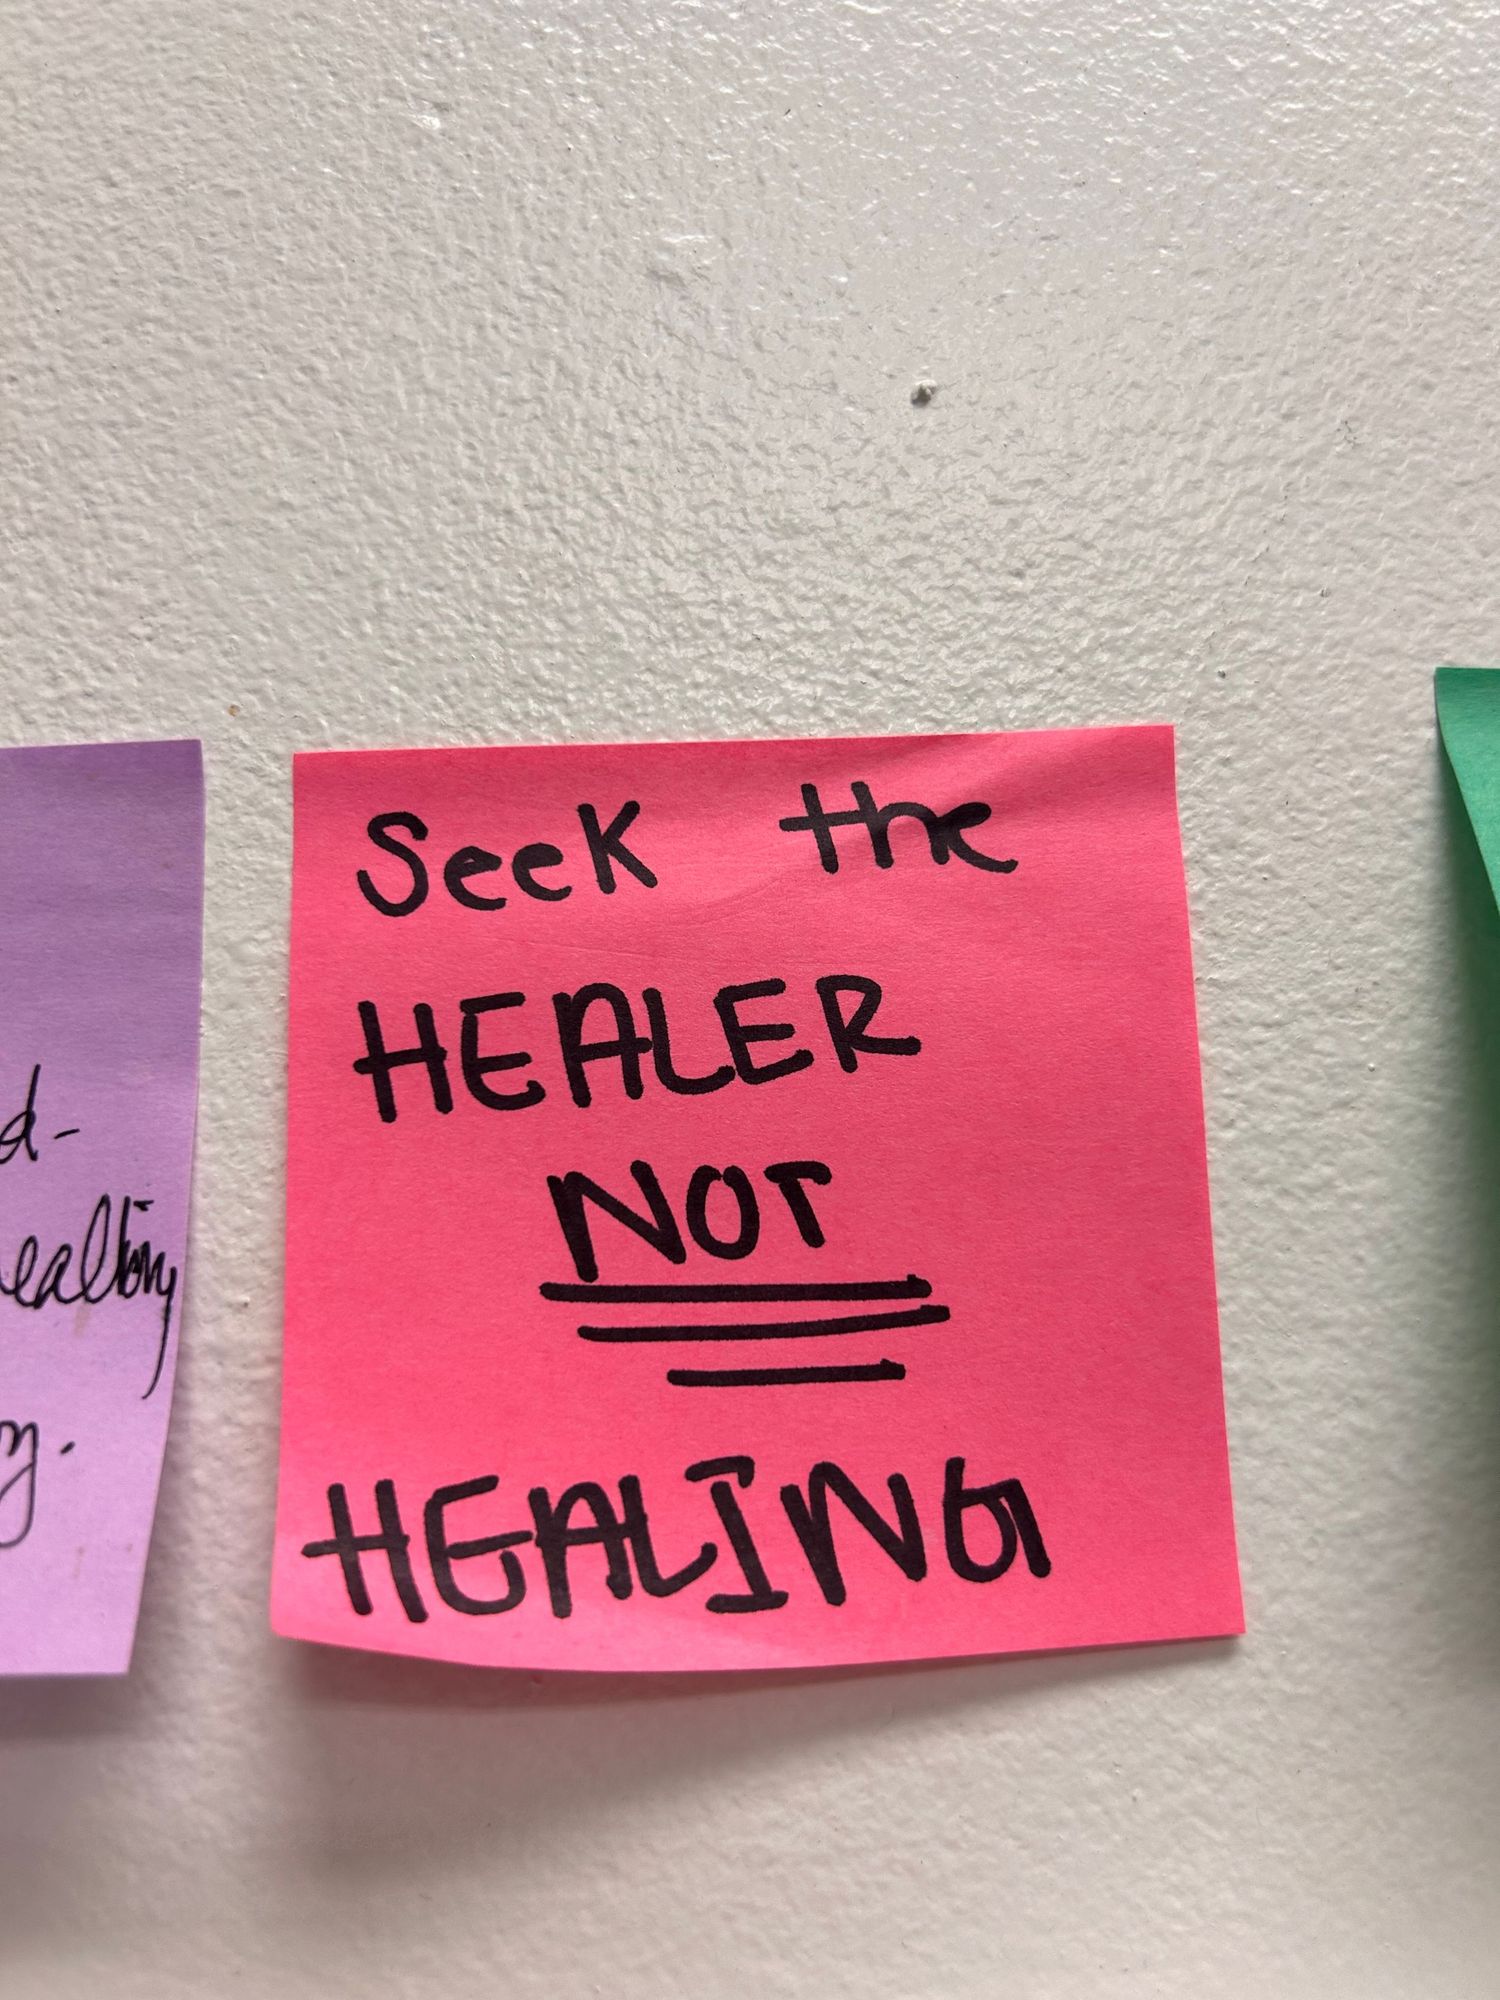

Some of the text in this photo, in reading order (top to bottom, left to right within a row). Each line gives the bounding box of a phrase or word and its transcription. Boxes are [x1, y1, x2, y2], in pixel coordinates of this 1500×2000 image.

[779, 781, 1018, 874] the
[353, 974, 921, 1123] HEALER
[545, 1159, 833, 1283] NOT
[303, 1457, 1051, 1623] HEALING
